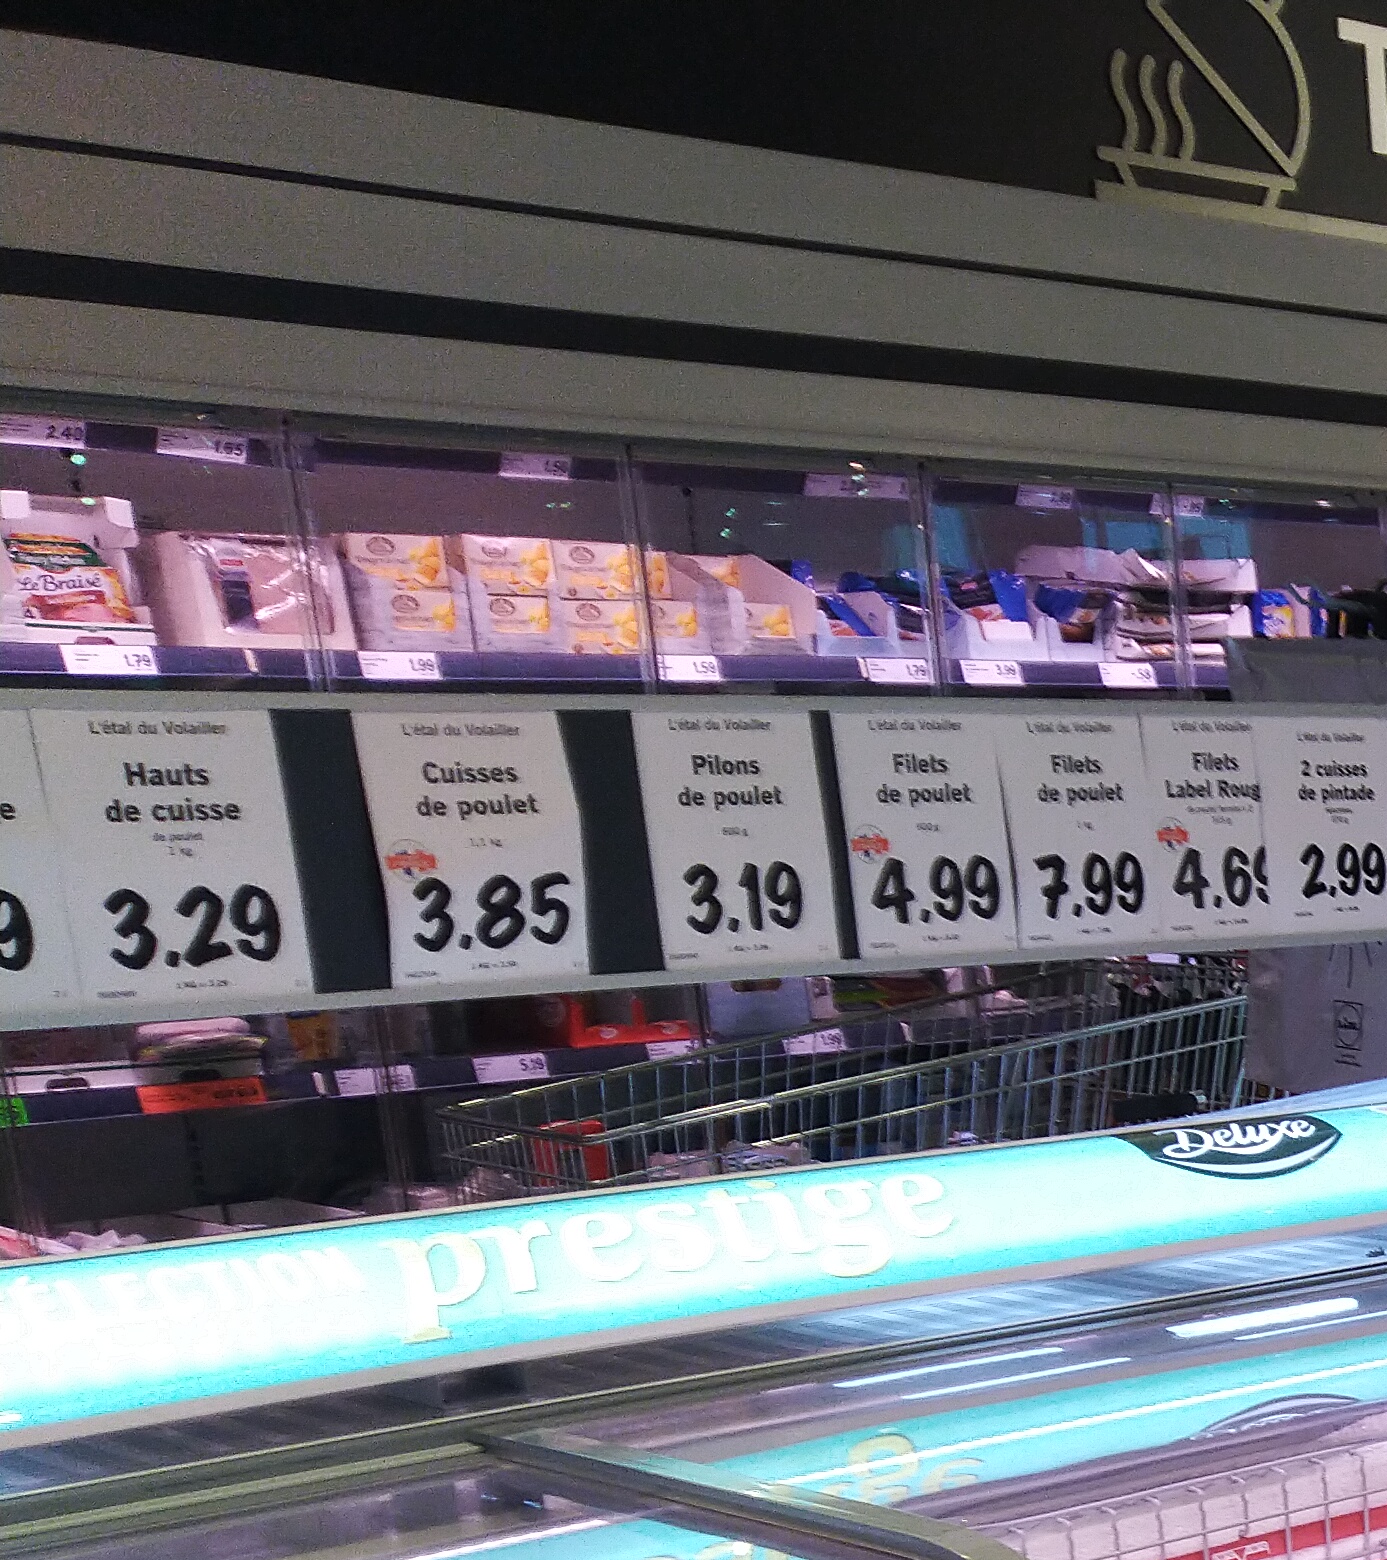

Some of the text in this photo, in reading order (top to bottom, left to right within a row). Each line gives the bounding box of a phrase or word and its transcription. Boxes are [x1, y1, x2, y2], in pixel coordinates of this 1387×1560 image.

[124, 761, 211, 787] Hauts
[422, 760, 520, 784] Cuisses
[691, 753, 761, 776] Pilons
[891, 752, 949, 775] Filets
[1050, 753, 1104, 775] Filets
[1191, 750, 1241, 773] Filets
[1300, 759, 1370, 778] 2 cuisses
[677, 784, 785, 811] de poulet
[875, 782, 973, 808] de poulet
[1037, 781, 1126, 808] de poulet
[1163, 778, 1263, 803] Label Roug
[1298, 783, 1377, 804] de pintade
[105, 796, 243, 823] de cuisse
[416, 793, 541, 821] de poulet
[1300, 842, 1387, 899] 2.99
[682, 860, 803, 935] 3.19
[871, 854, 1001, 926] 4.99
[1033, 850, 1145, 919] 7.99
[412, 871, 571, 953] 3.85
[103, 883, 282, 970] 3.29
[1161, 1115, 1318, 1165] Deluxe
[380, 1169, 957, 1344] prestige
